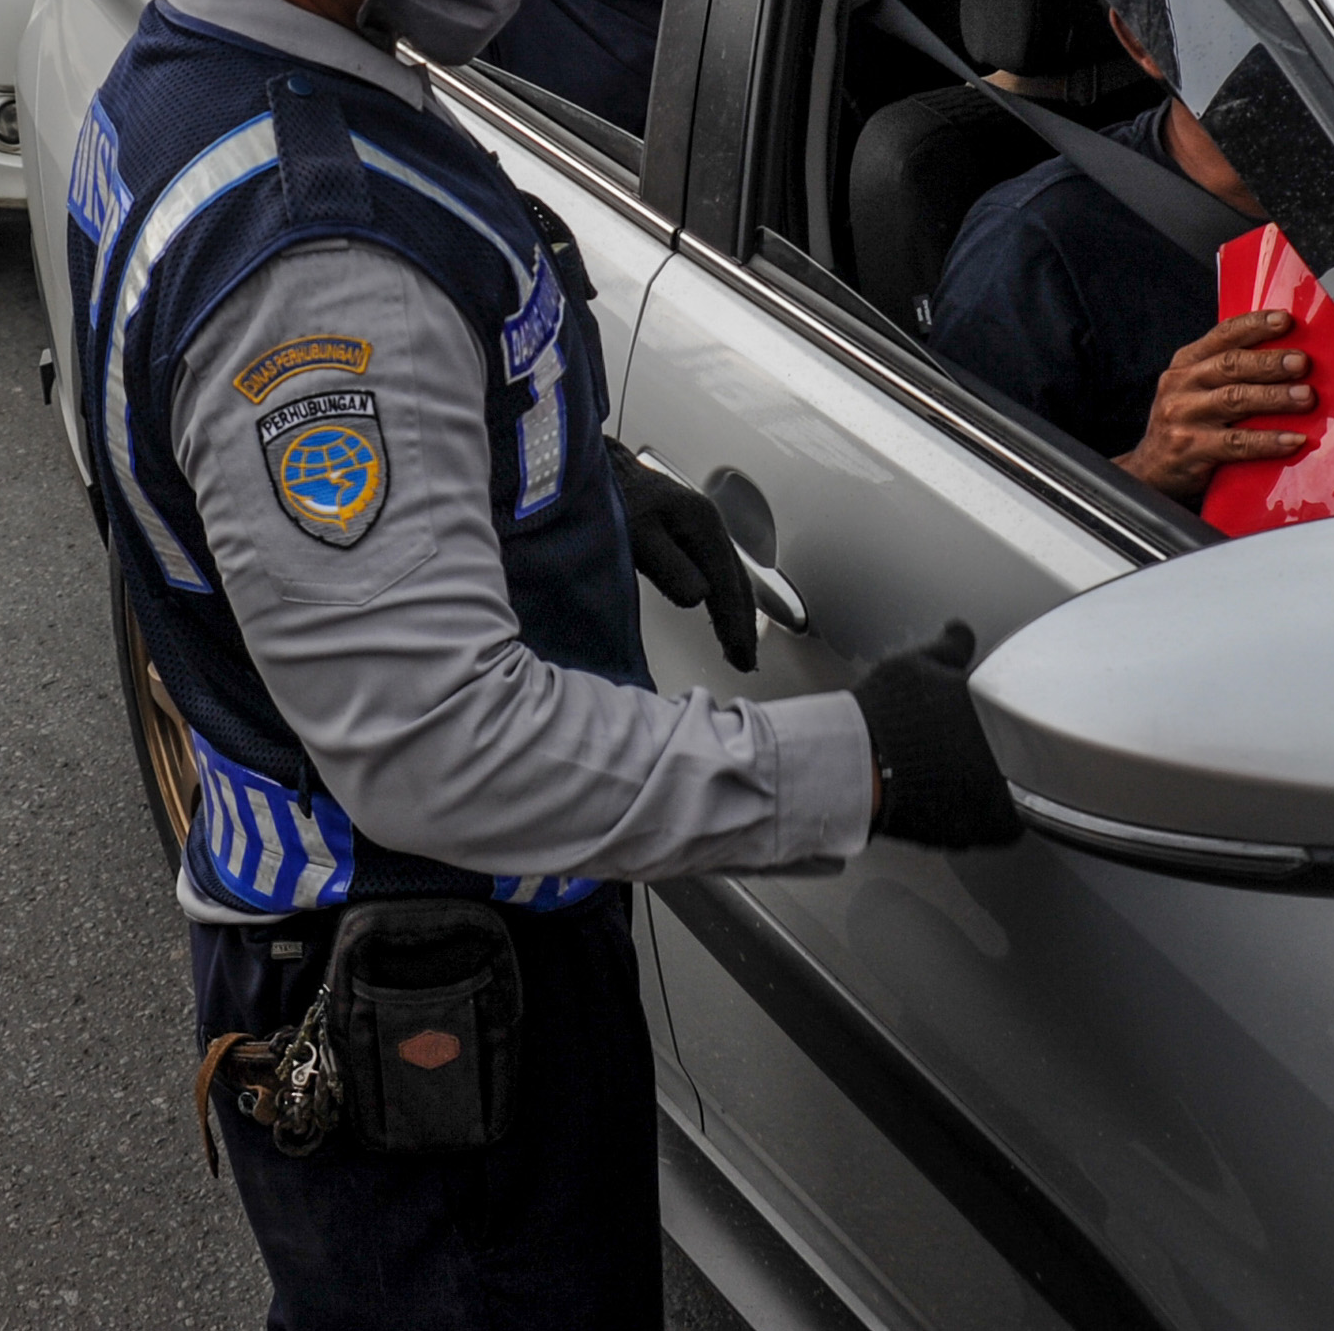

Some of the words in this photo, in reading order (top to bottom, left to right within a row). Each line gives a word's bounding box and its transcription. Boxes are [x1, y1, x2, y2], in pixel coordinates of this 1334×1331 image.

[243, 359, 276, 394] DINAS
[274, 342, 364, 369] PERHUBUNGAN
[262, 395, 368, 437] PERHUBUNGAN
